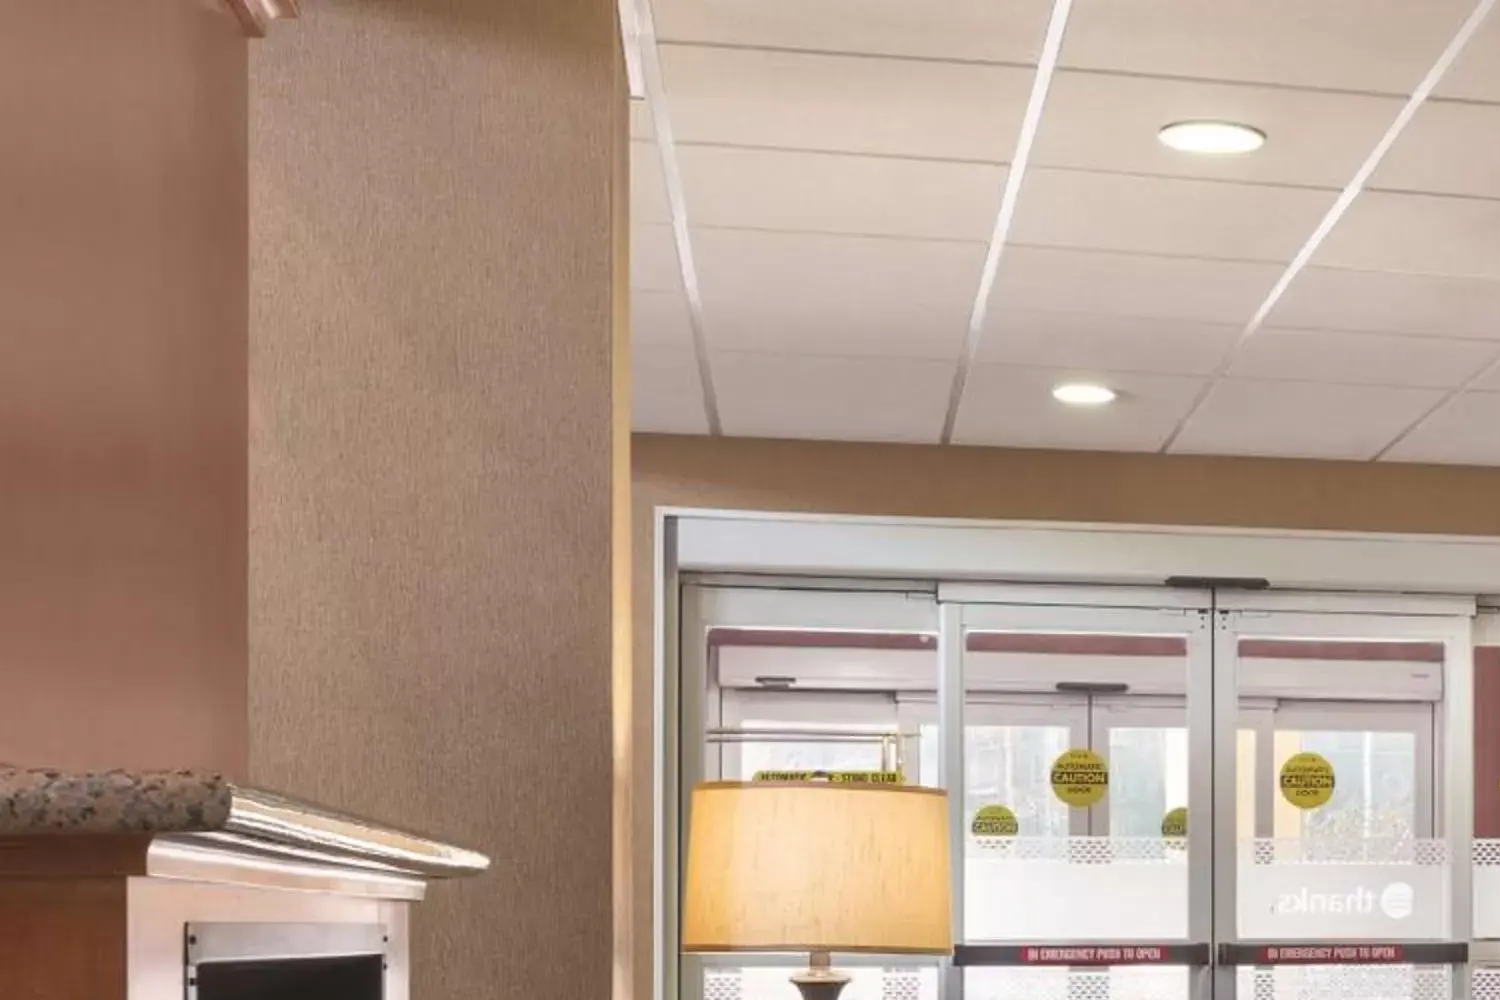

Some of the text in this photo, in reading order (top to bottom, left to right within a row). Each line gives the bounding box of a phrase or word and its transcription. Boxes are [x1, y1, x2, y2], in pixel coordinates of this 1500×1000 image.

[1054, 773, 1105, 783] CAUTION
[1283, 776, 1332, 787] CAUTION
[1040, 947, 1096, 960] EMERGENCY
[1096, 947, 1121, 960] PUSH
[1122, 947, 1134, 960] TO
[1135, 947, 1161, 960] OPEN
[1280, 947, 1333, 959] EMERGENCY
[1333, 947, 1358, 959] PUSH
[1359, 946, 1370, 959] TO
[1371, 946, 1396, 959] OPEN
